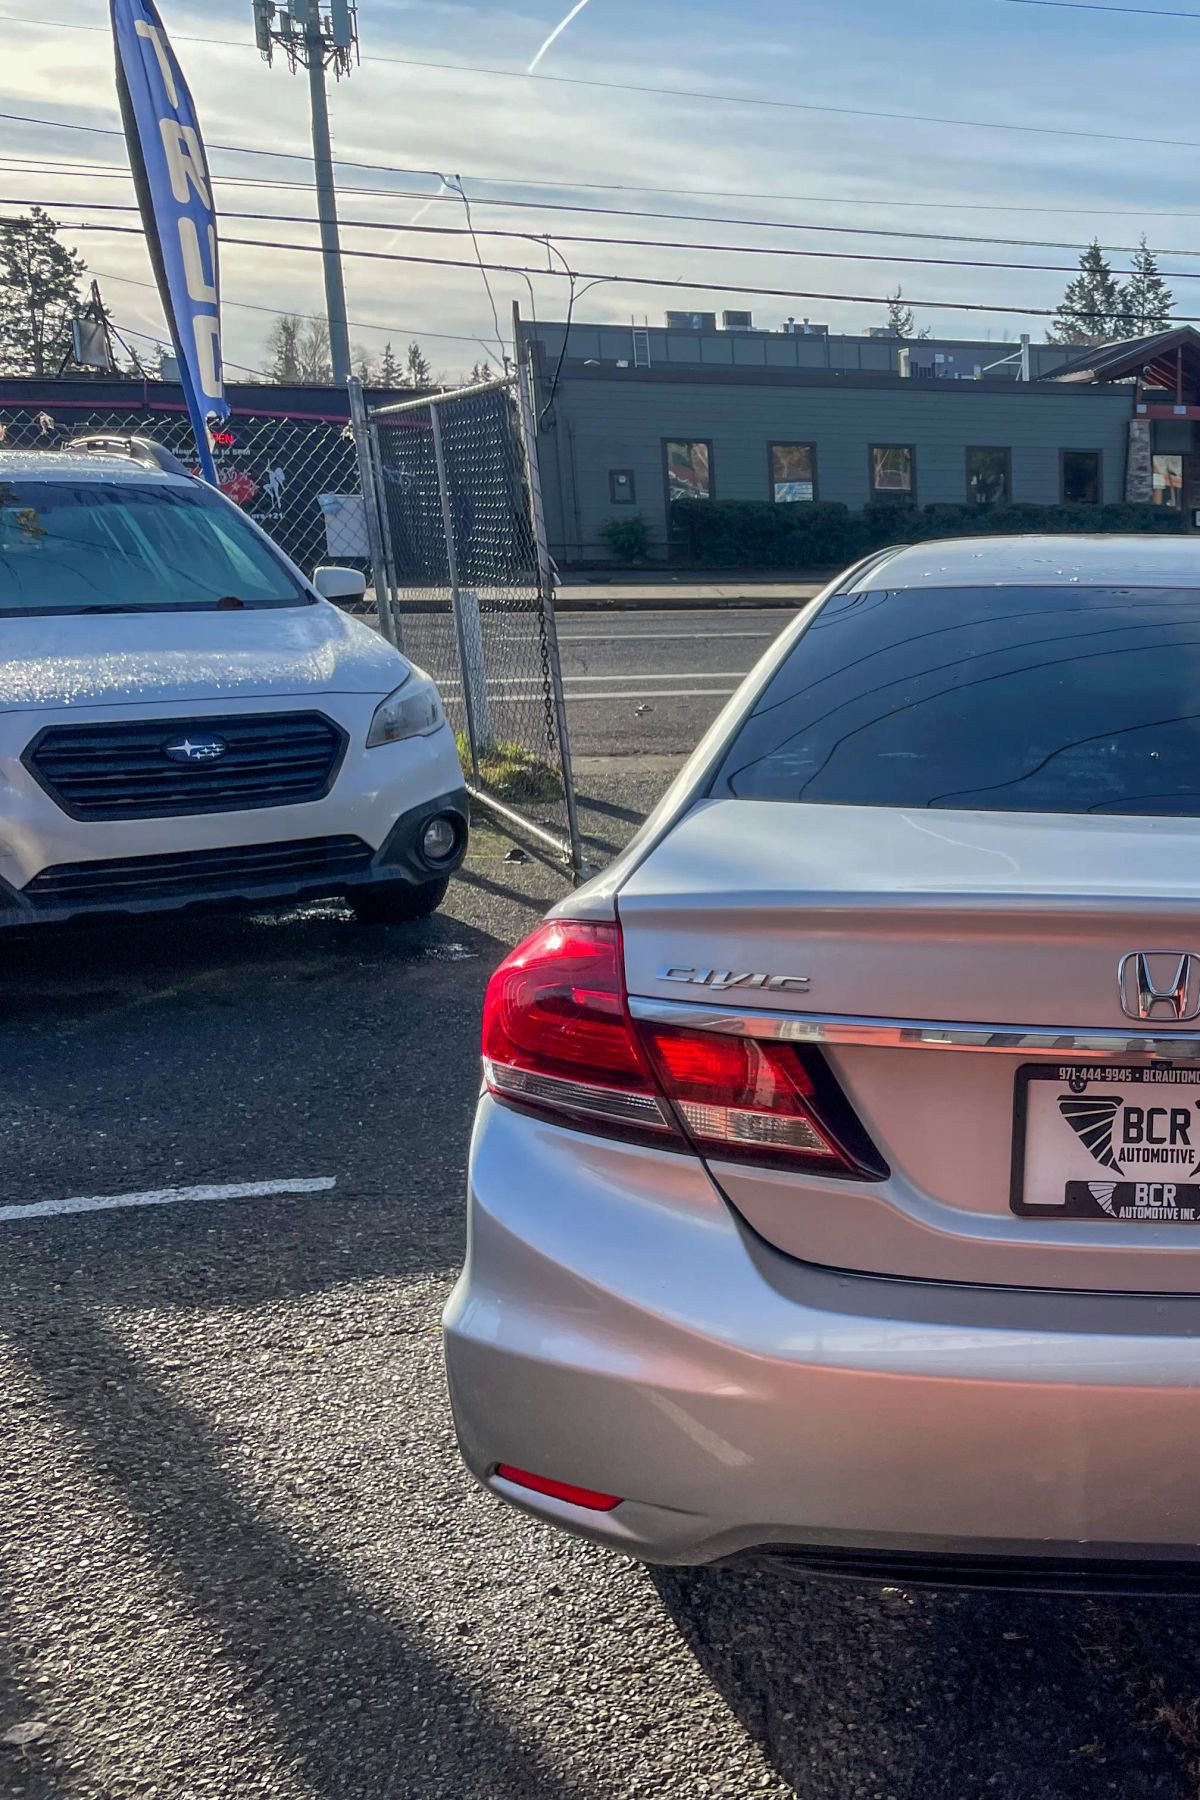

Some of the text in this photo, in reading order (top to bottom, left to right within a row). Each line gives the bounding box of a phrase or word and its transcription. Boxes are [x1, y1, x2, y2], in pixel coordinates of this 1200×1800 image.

[134, 18, 224, 426] TRUC
[656, 965, 812, 993] CIVIC
[1059, 1067, 1132, 1082] 971-444-9945
[1123, 1107, 1191, 1145] BCR
[1118, 1147, 1195, 1164] AUTOMOTIVE
[1135, 1183, 1177, 1207] BCR
[1118, 1207, 1196, 1221] AUTOMOTIVE INC
